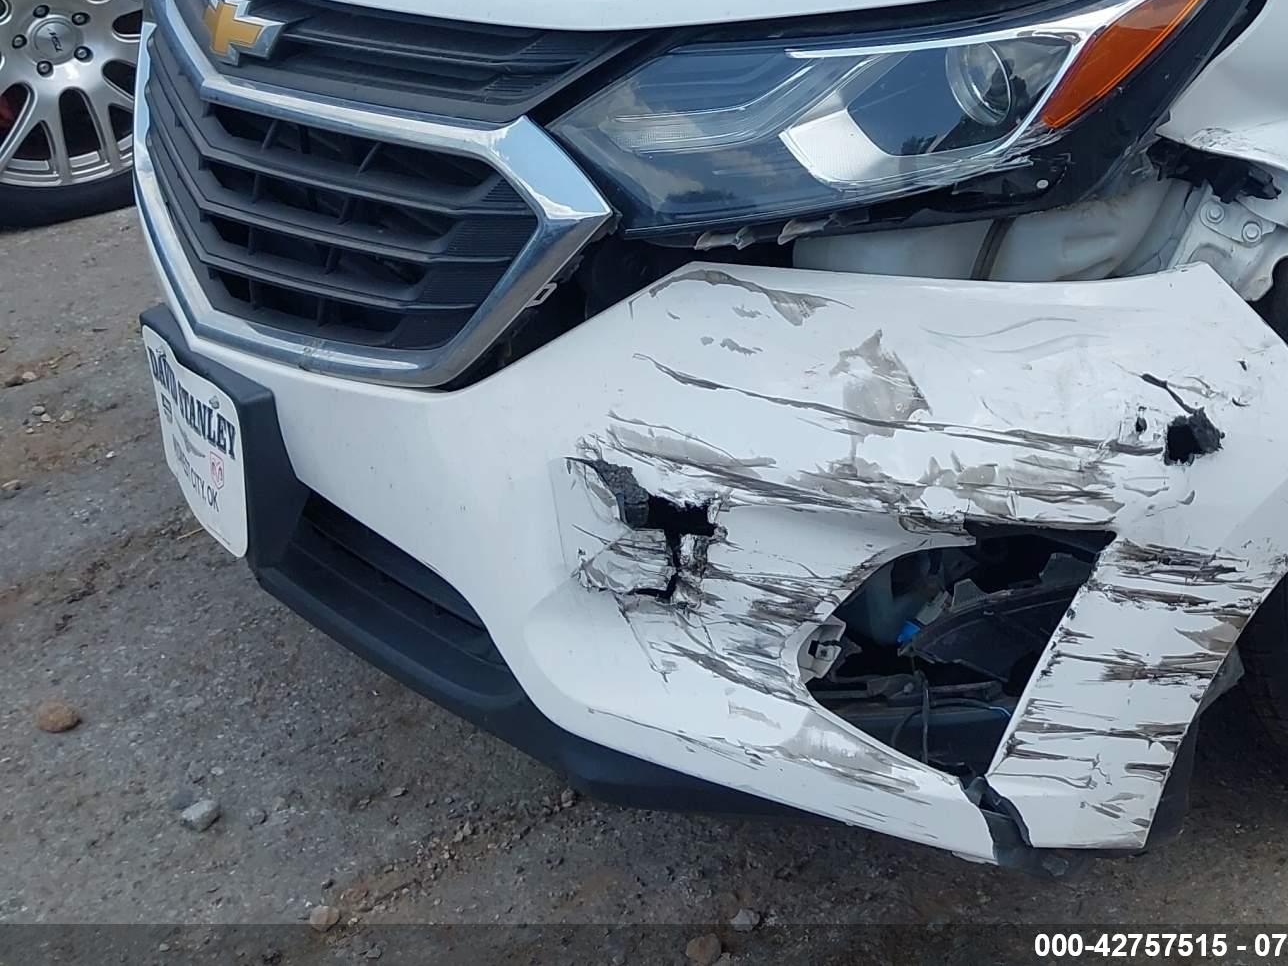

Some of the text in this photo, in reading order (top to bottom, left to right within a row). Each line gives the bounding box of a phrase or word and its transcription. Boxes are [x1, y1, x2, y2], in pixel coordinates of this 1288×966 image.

[147, 346, 179, 406] DAVID
[178, 380, 236, 461] STANLEY
[206, 485, 220, 513] OK
